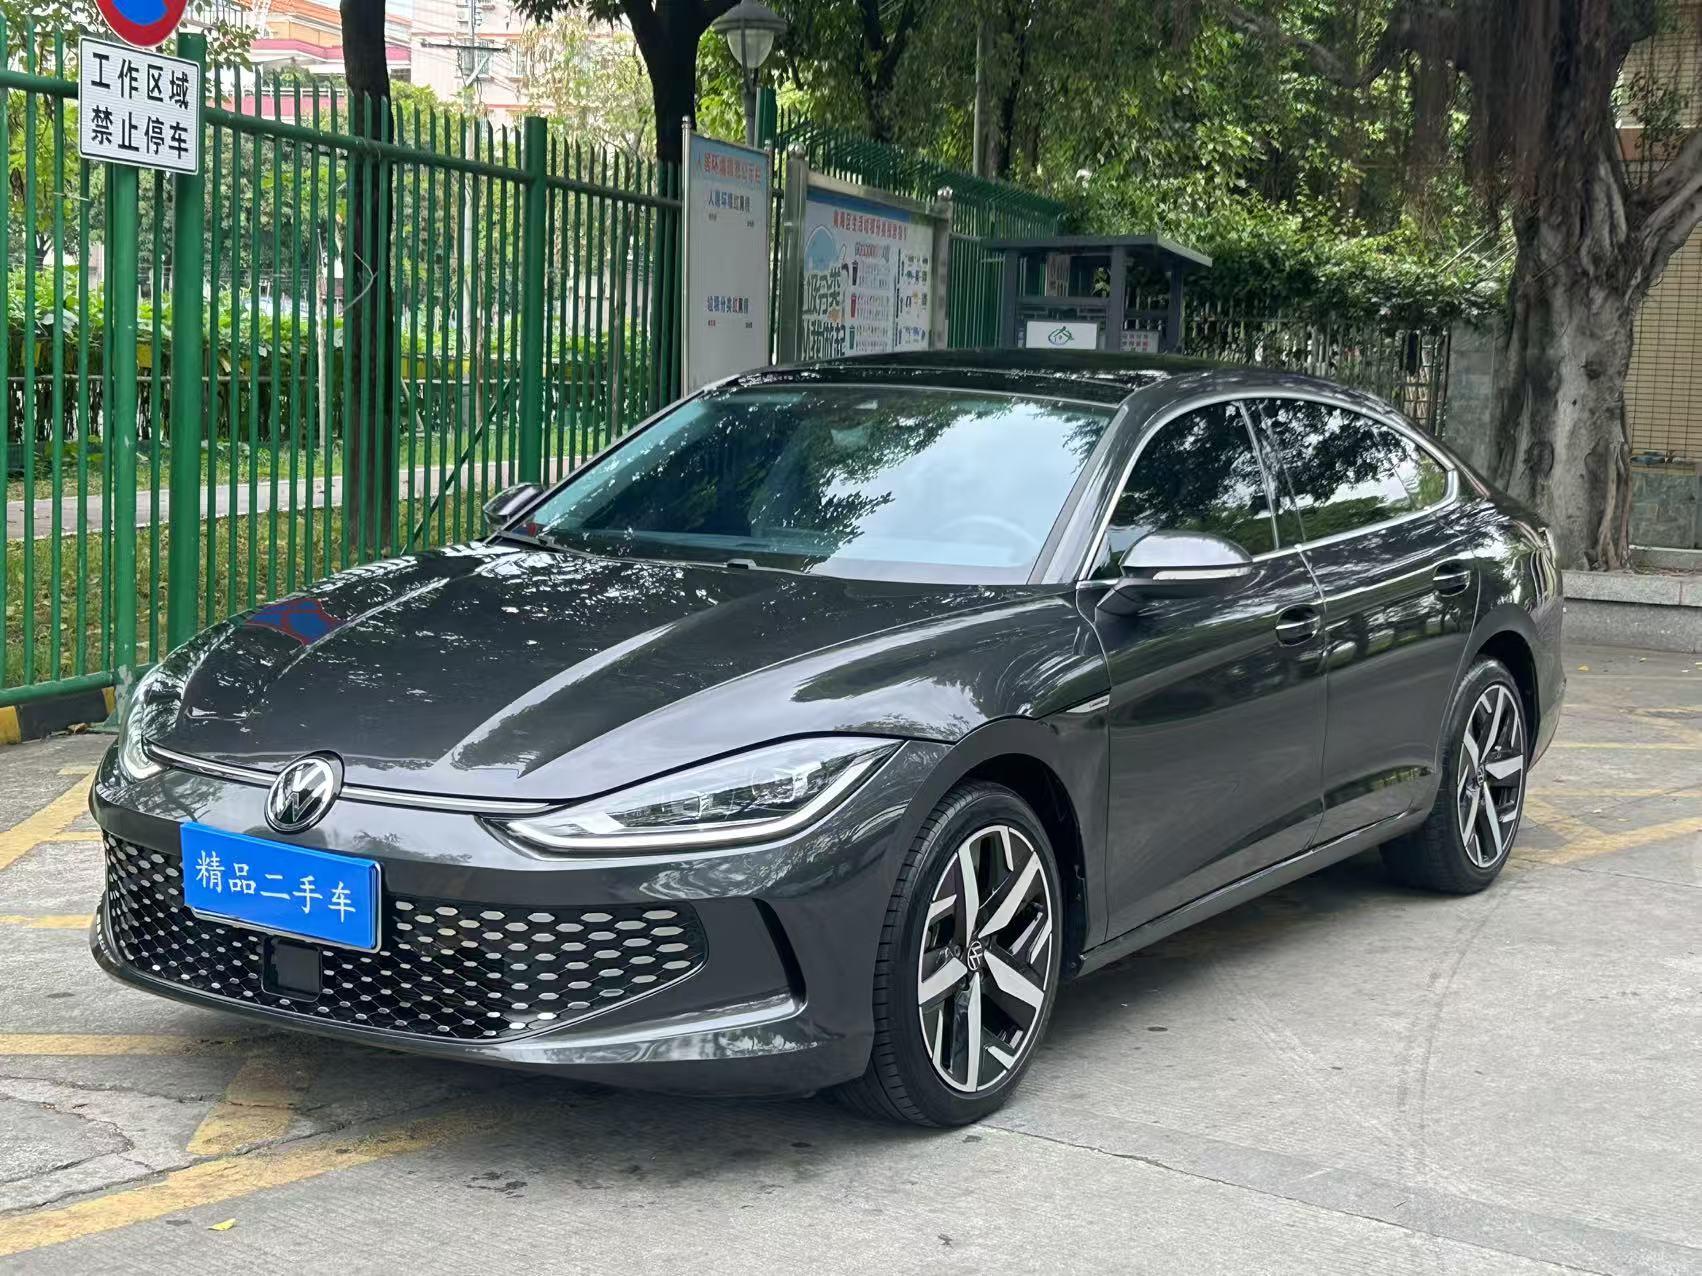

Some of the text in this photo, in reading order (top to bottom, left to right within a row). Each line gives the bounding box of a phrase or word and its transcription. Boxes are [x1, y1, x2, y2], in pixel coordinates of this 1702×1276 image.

[91, 51, 189, 110] 工作区域
[91, 104, 190, 160] 禁止停车
[195, 850, 356, 924] 精品二手车
